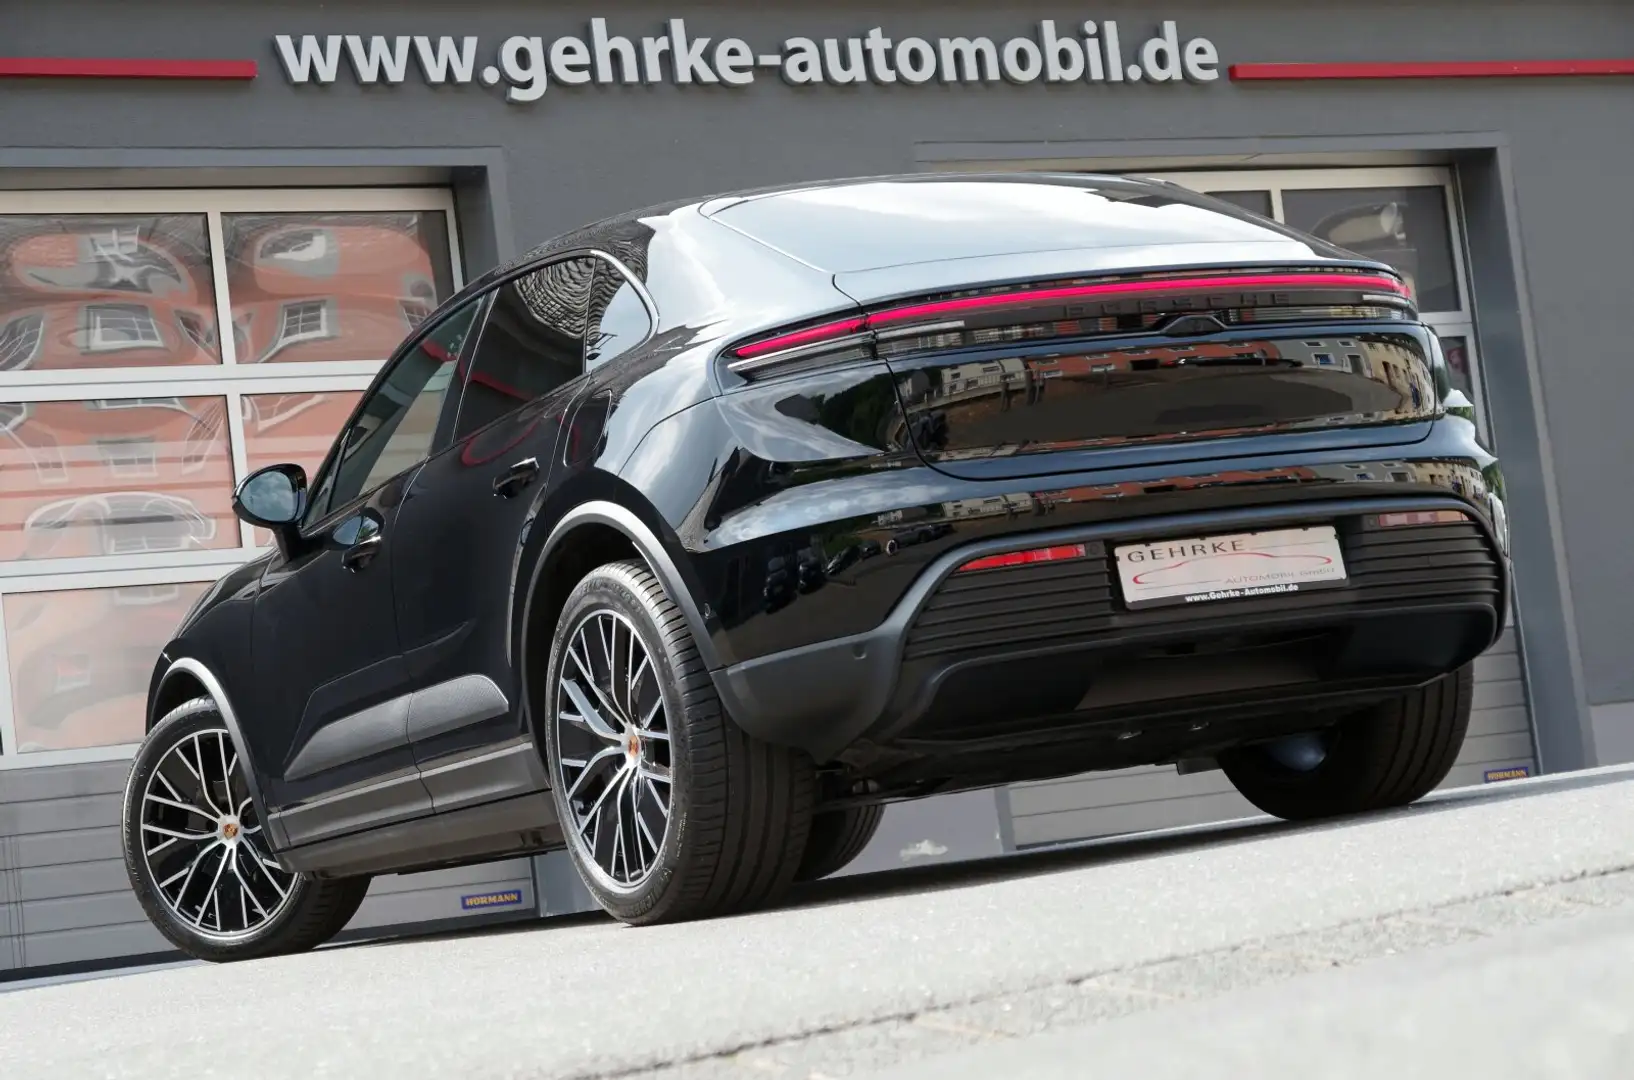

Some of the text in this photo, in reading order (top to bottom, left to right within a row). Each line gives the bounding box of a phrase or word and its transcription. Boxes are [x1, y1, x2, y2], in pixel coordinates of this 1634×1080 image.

[274, 17, 1219, 103] www.gehrke-automobil.de
[1127, 539, 1247, 563] GEHRKE
[1185, 583, 1299, 602] www.Gehrke-Automobil.de
